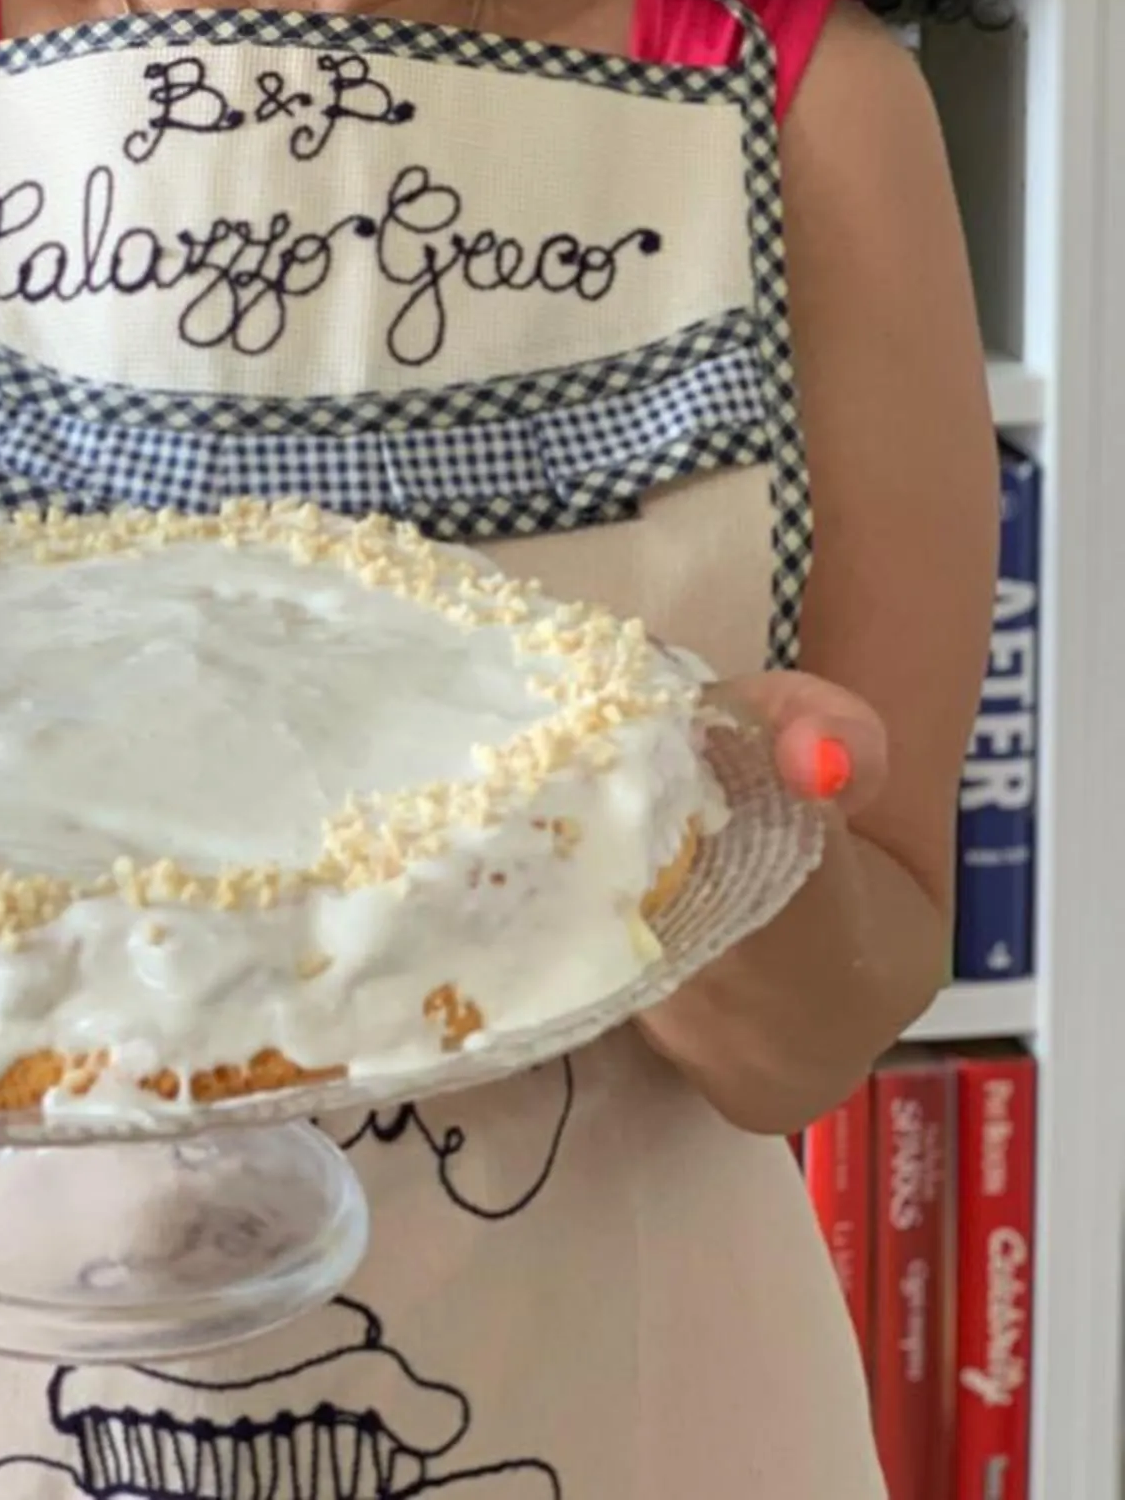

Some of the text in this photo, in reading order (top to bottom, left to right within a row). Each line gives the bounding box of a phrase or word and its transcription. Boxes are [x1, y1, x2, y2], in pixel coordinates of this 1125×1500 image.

[375, 164, 661, 367] Greco
[959, 576, 1036, 813] AFTER
[960, 1225, 1027, 1407] Celebrity
